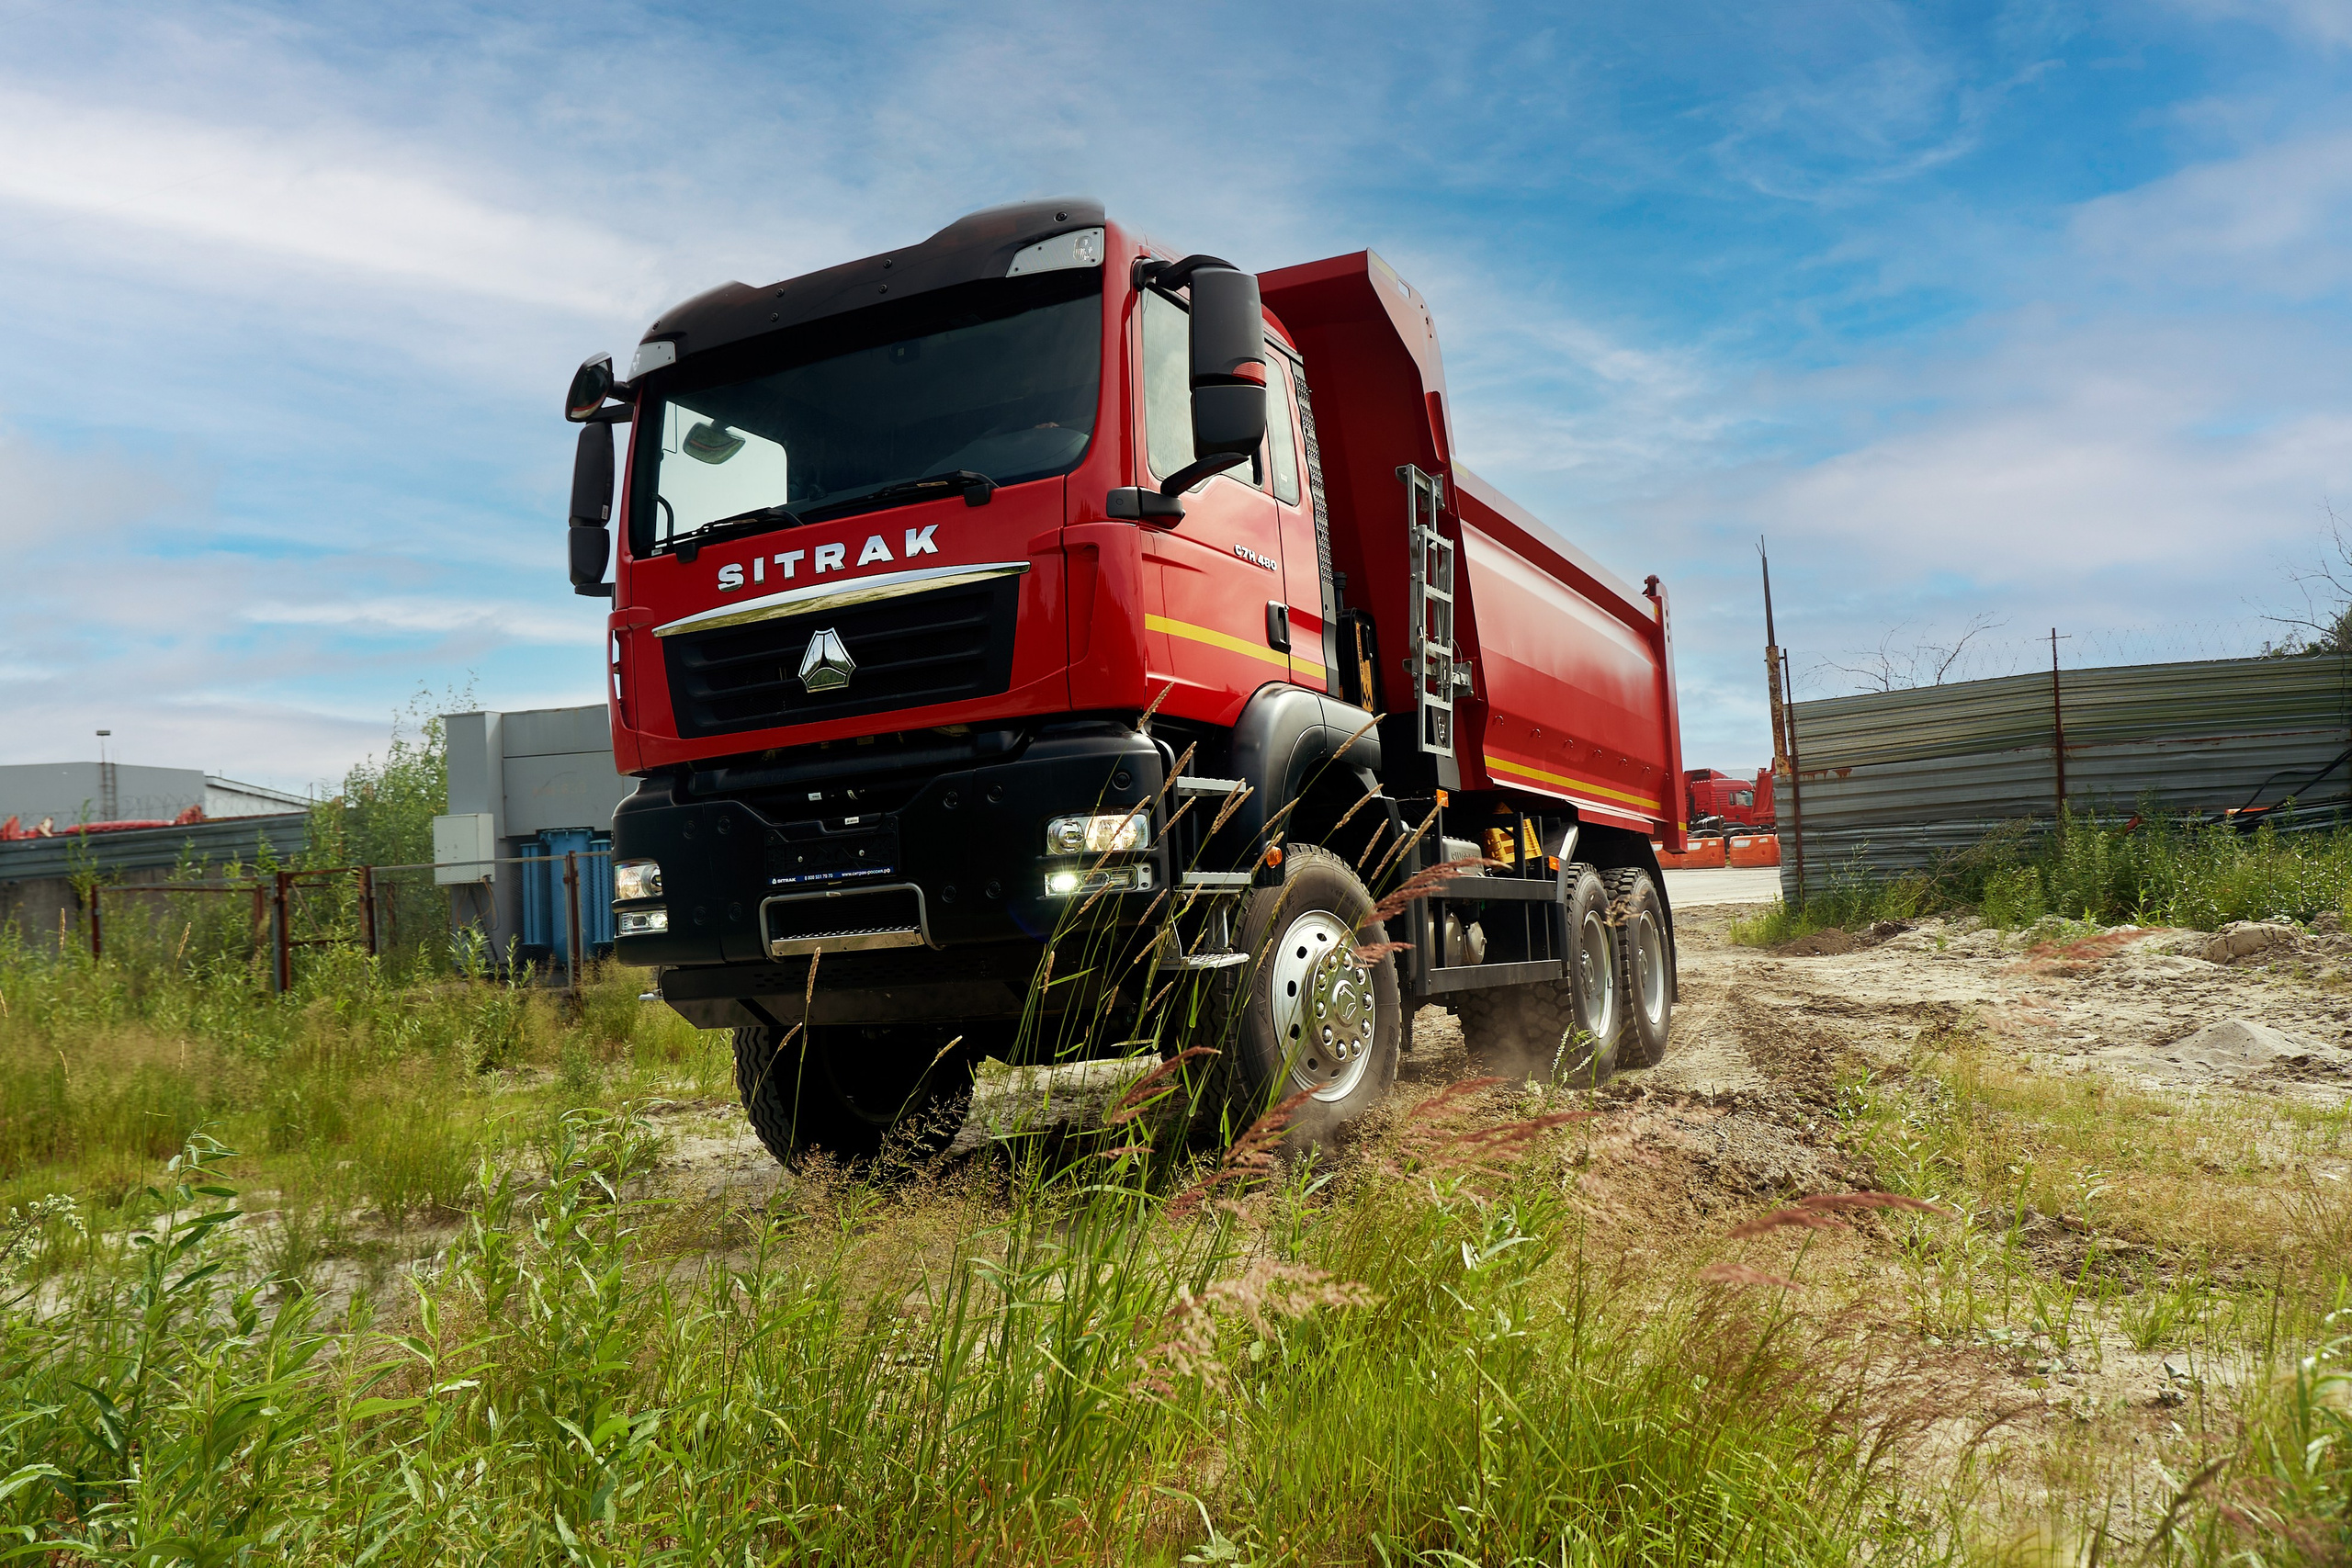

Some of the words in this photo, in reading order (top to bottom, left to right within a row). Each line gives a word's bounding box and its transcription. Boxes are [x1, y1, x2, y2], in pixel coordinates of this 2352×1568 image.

[718, 524, 939, 592] SITRAK
[1234, 544, 1256, 562] C7H
[1257, 554, 1278, 571] 480
